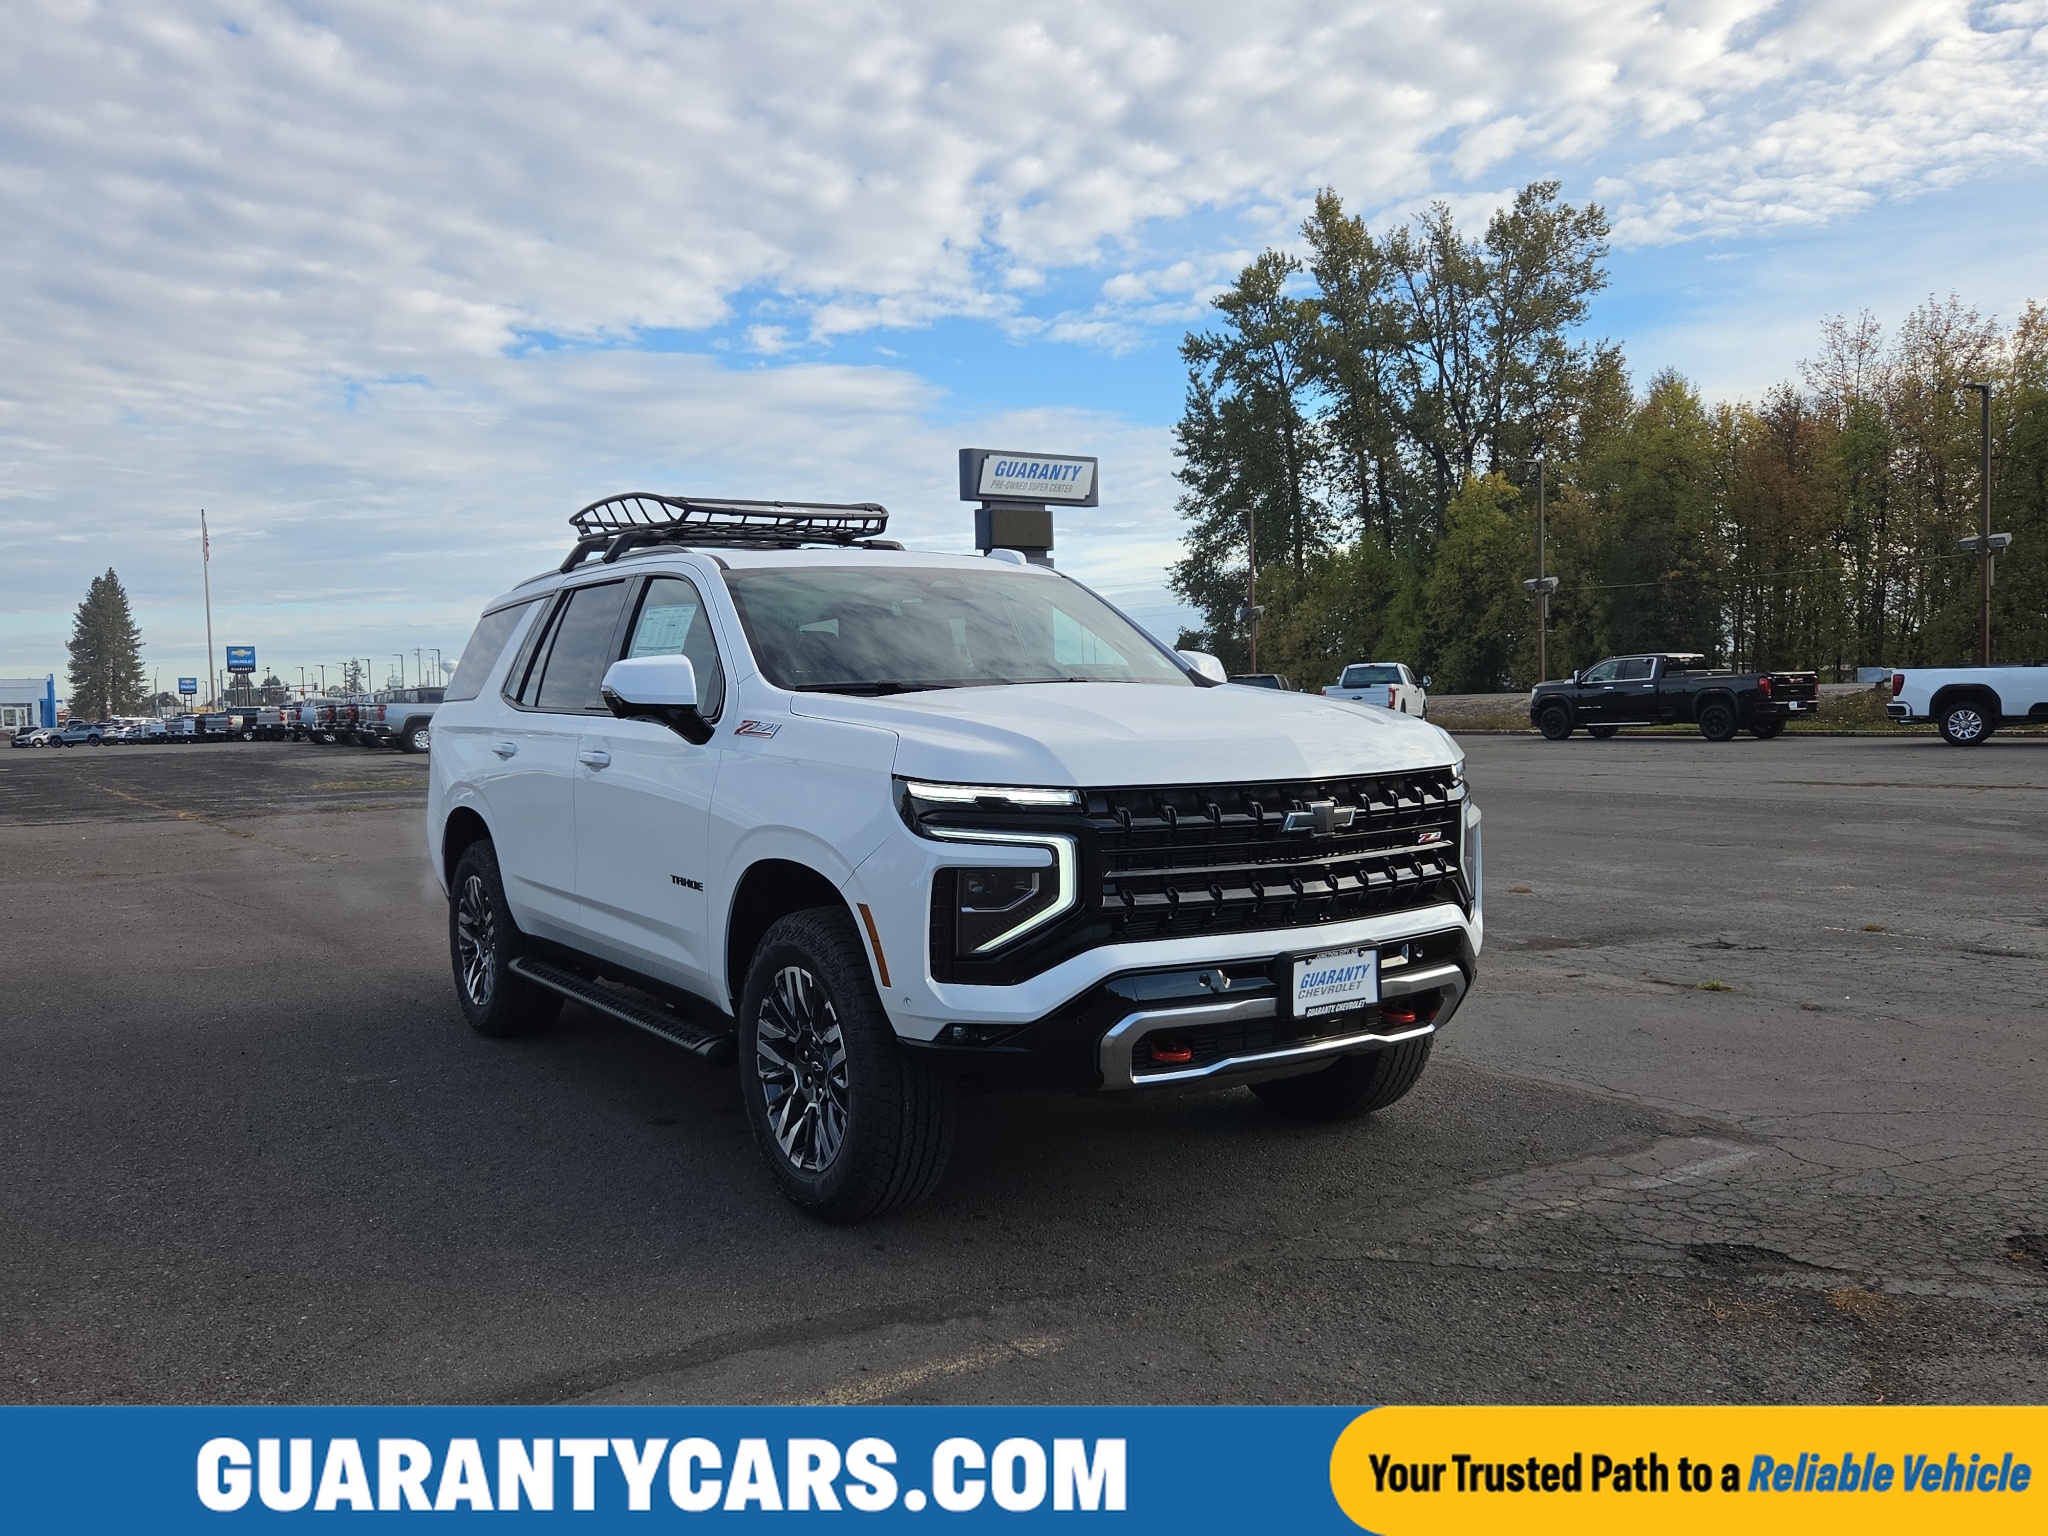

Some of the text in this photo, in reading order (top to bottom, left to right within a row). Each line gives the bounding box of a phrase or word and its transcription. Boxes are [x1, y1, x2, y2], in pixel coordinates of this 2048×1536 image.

[994, 460, 1083, 481] GUARANTY
[990, 479, 1074, 494] PRE-OWNED SUPER CENTER
[734, 720, 782, 739] Z71
[670, 874, 704, 892] TAHOE
[1300, 963, 1370, 989] GUARANTY
[1297, 980, 1364, 999] CHEVROLET
[1335, 1000, 1366, 1012] CHEVROLET
